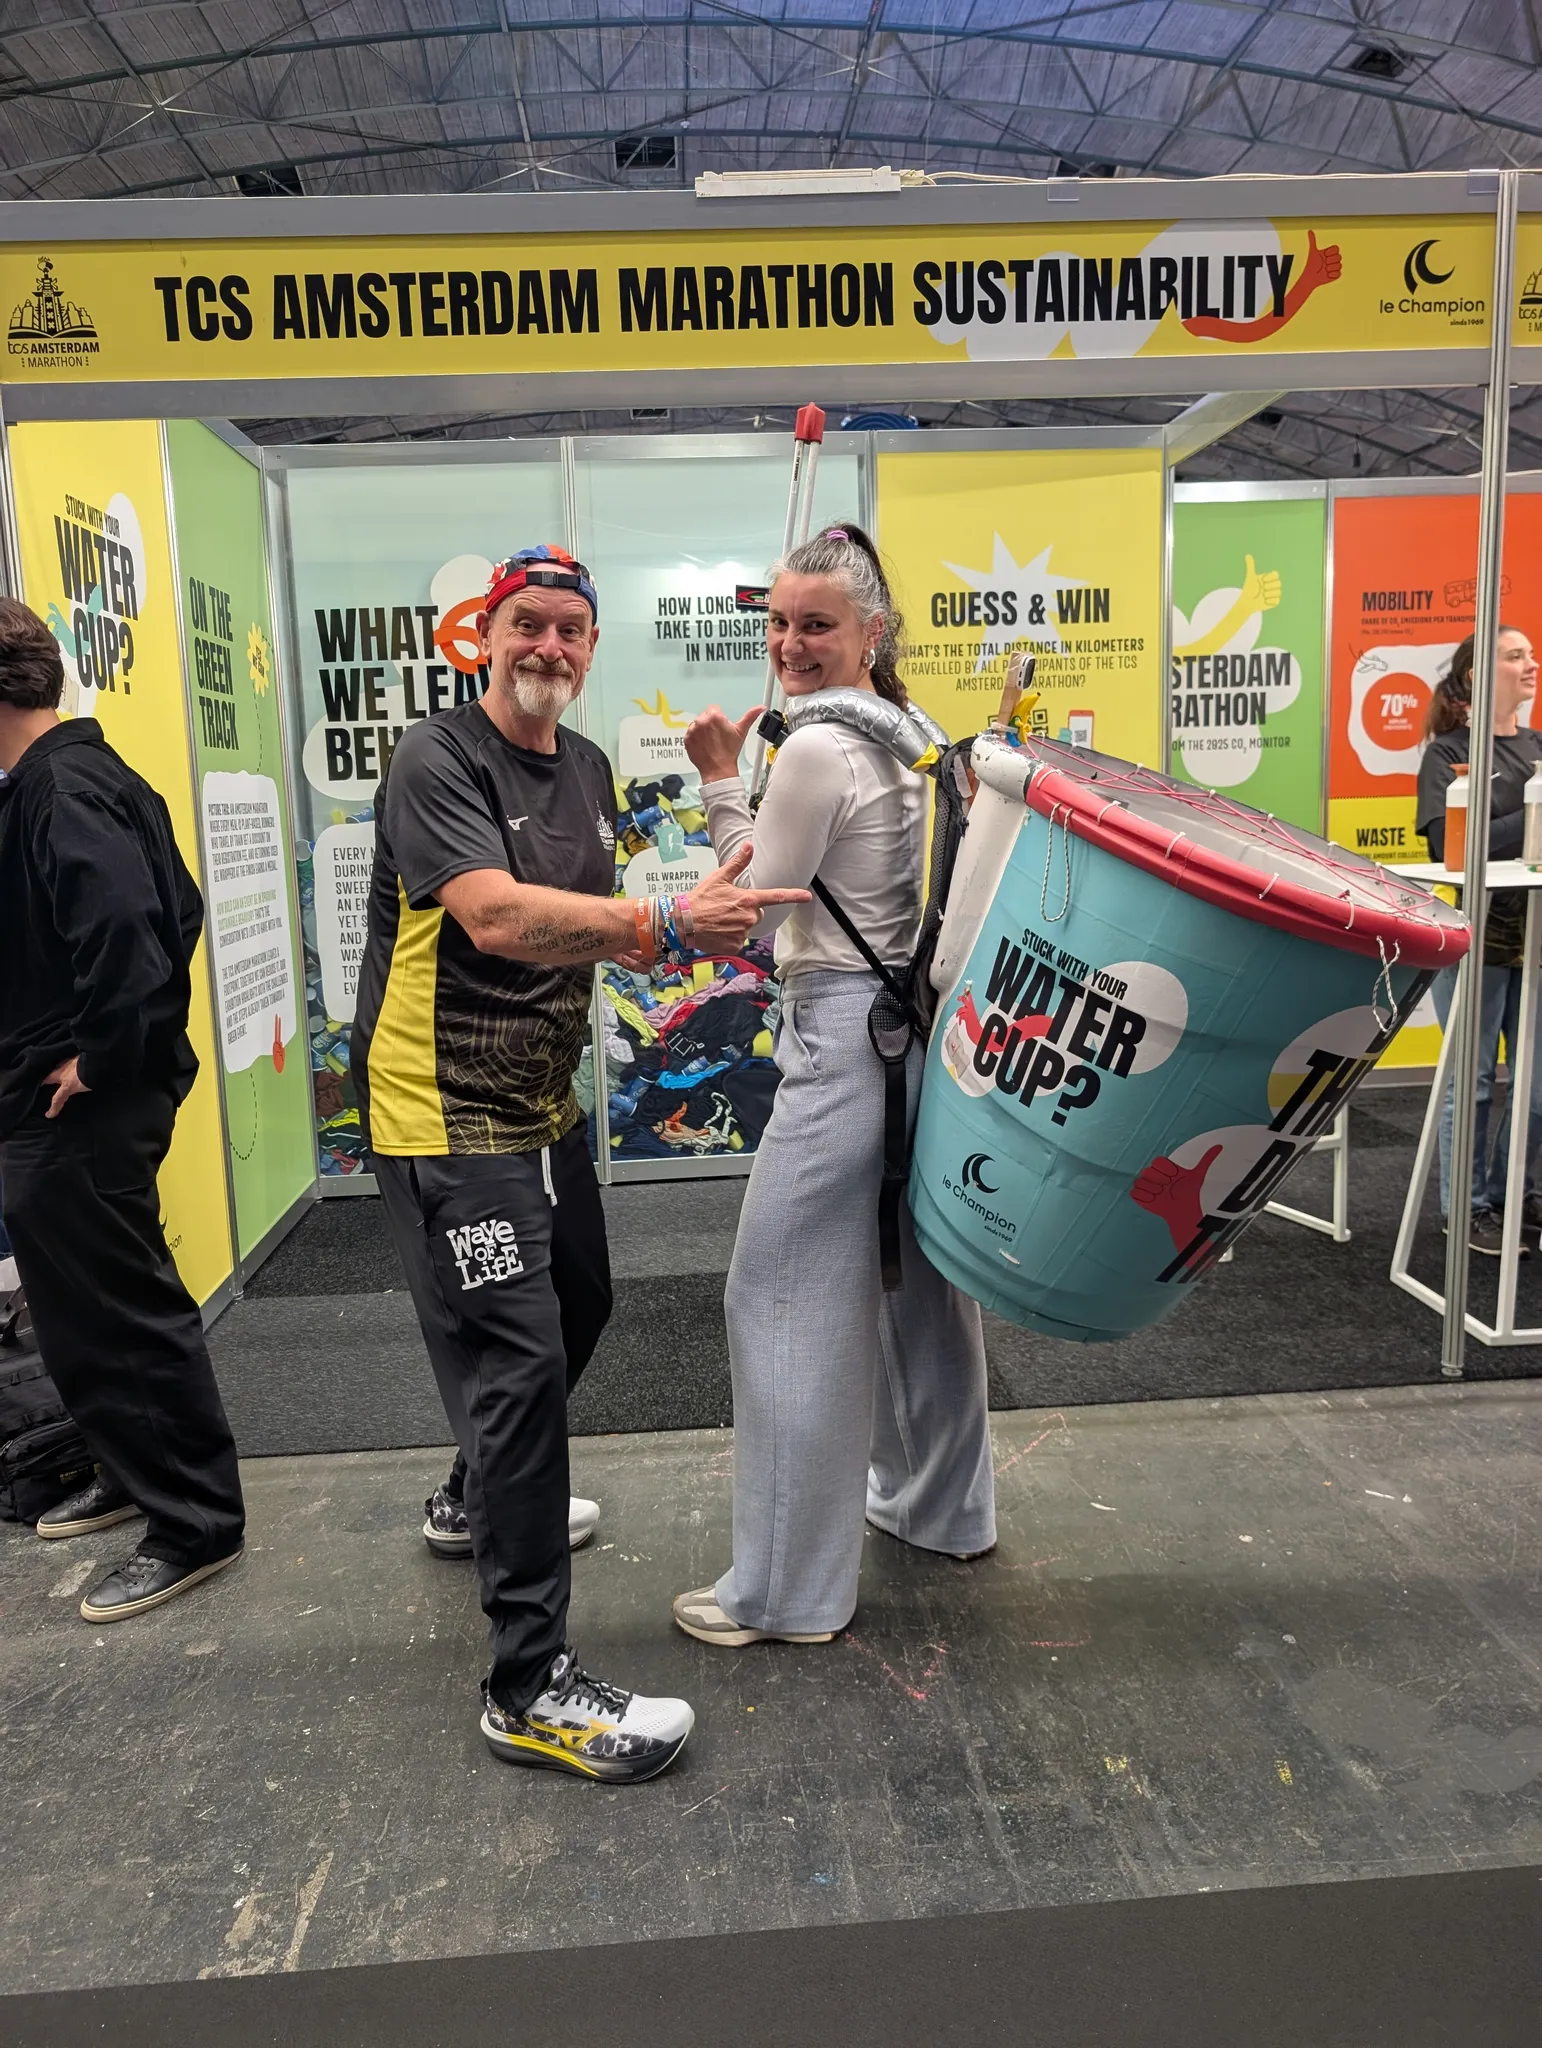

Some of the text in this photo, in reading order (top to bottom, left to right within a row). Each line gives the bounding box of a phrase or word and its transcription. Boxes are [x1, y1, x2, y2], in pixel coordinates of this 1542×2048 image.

[154, 254, 1294, 342] TCS AMSTERDAM MARATHON SUSTAINABILITY
[1380, 297, 1485, 316] le Champion
[28, 356, 83, 368] MARATHON
[54, 514, 138, 621] WATER
[189, 576, 233, 642] ON THE
[658, 595, 734, 616] HOW LONG
[931, 588, 1110, 628] GUESS & WIN
[1362, 590, 1434, 612] MOBILITY
[314, 605, 439, 662] WHAT
[655, 620, 691, 640] TAKE
[695, 619, 713, 639] TO
[73, 607, 134, 695] CUP?
[686, 641, 768, 662] IN NATURE?
[943, 642, 964, 658] THE
[968, 642, 1001, 657] TOTAL
[1004, 640, 1057, 656] DISTANCE
[1060, 640, 1072, 654] IN
[1075, 637, 1144, 654] KILOMETERS
[194, 637, 233, 696] GREEN
[905, 661, 961, 677] TRAVELLED
[965, 659, 979, 675] BY
[980, 659, 999, 674] ALL
[1079, 656, 1092, 670] OF
[1095, 655, 1115, 670] THE
[1117, 655, 1137, 669] TCS
[955, 674, 1086, 692] AMSTERD ARATHON?
[319, 667, 388, 722] WE
[1380, 693, 1418, 718] 70%
[199, 696, 239, 750] TRACK
[640, 736, 673, 747] BANANA
[1188, 739, 1204, 751] THE
[1249, 736, 1291, 749] MONITOR
[650, 748, 684, 759] 1 MONTH
[1356, 827, 1406, 847] WASTE
[333, 847, 366, 861] EVERY
[646, 870, 700, 882] GEL WRAPPER
[337, 898, 352, 911] AN
[337, 914, 358, 928] YET
[340, 931, 362, 945] AND
[1021, 928, 1128, 1001] STUCK WITH YOUR
[985, 935, 1147, 1080] WATER
[972, 1013, 1101, 1127] CUP?
[942, 1174, 1017, 1234] le Champion
